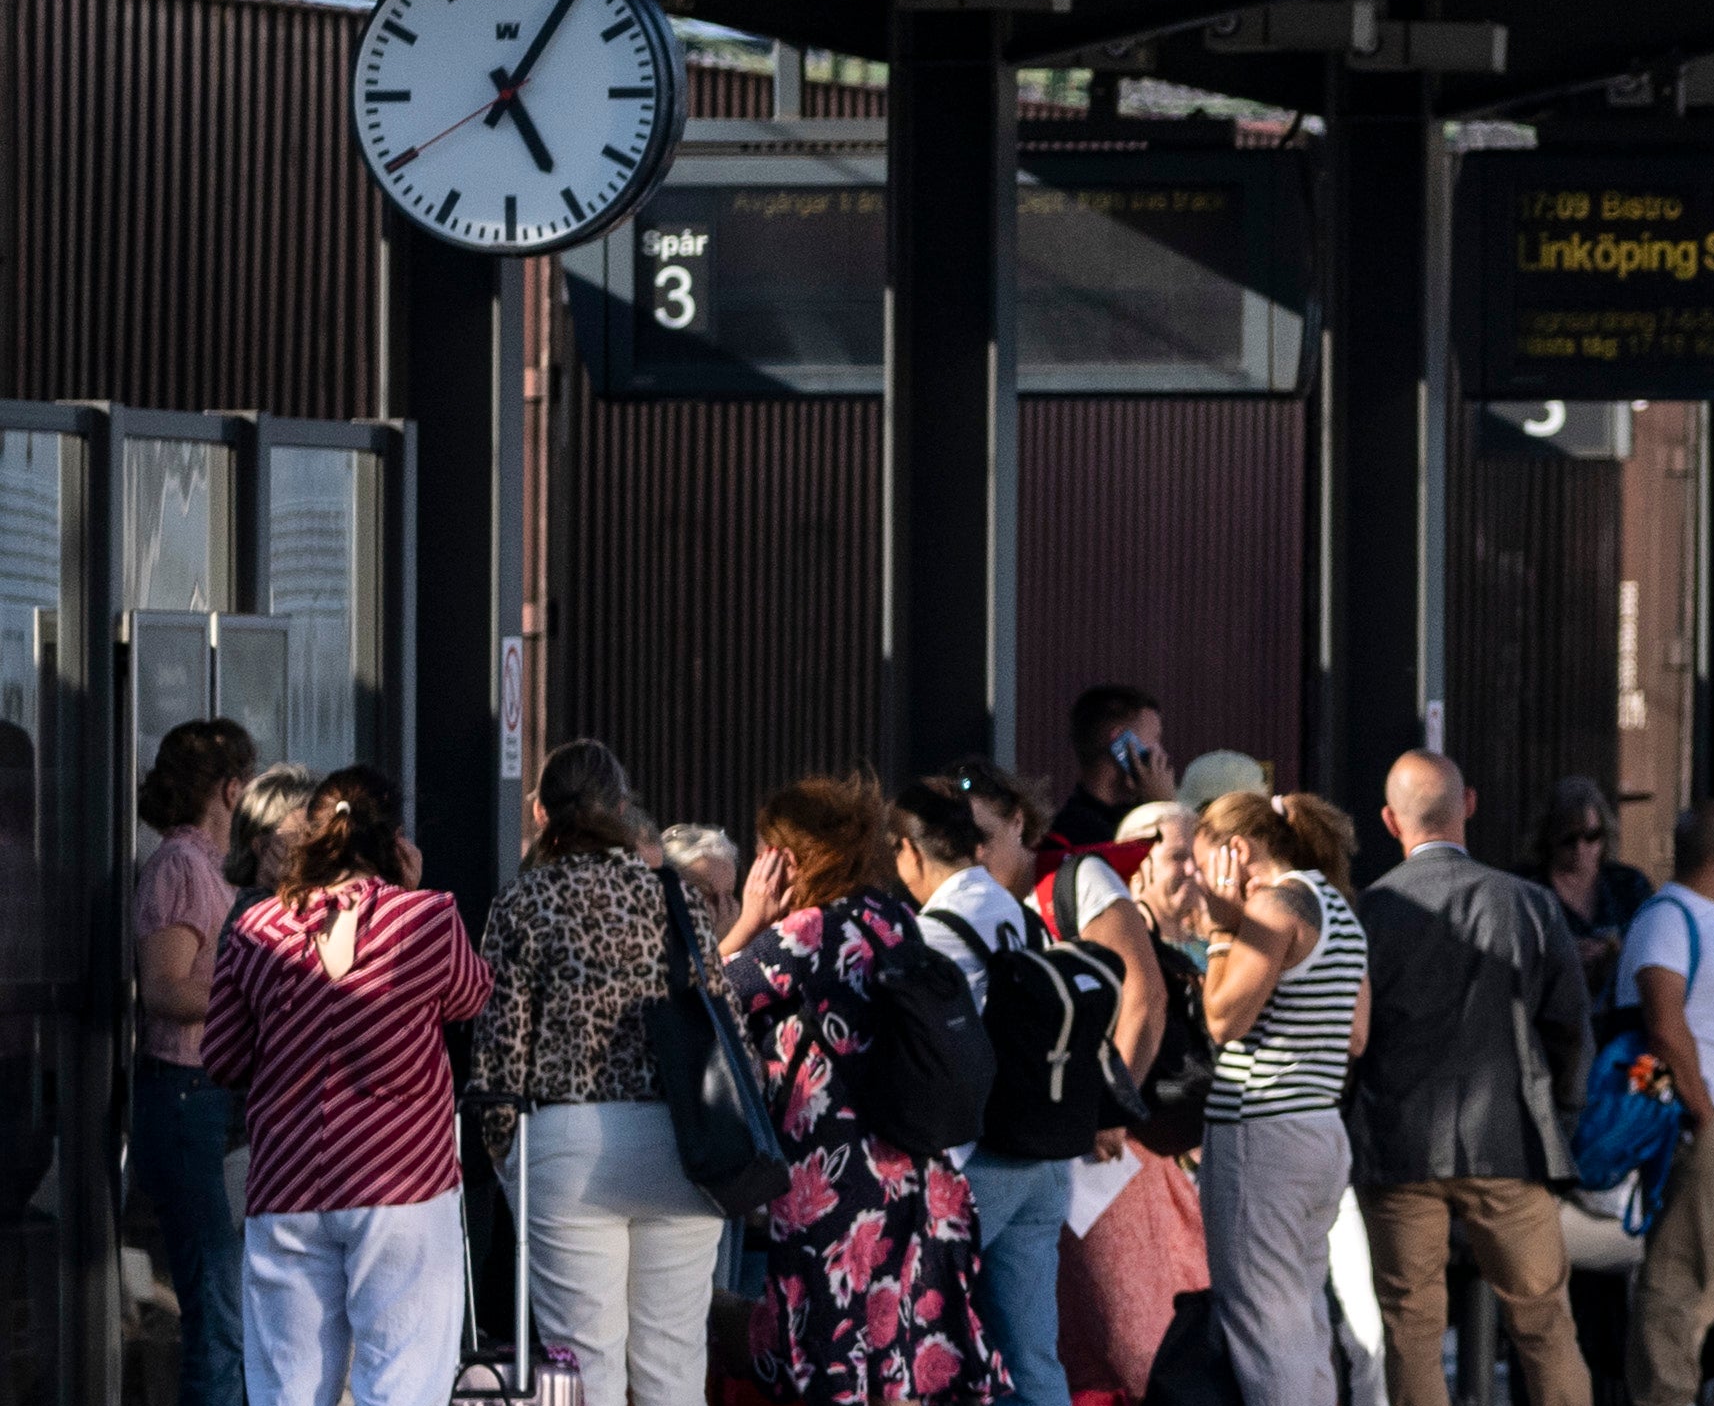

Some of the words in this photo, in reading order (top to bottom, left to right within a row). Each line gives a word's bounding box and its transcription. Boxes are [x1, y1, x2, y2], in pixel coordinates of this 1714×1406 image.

[496, 22, 520, 41] W
[642, 228, 709, 262] Spår
[1518, 231, 1699, 281] Linköping
[654, 264, 696, 329] 3
